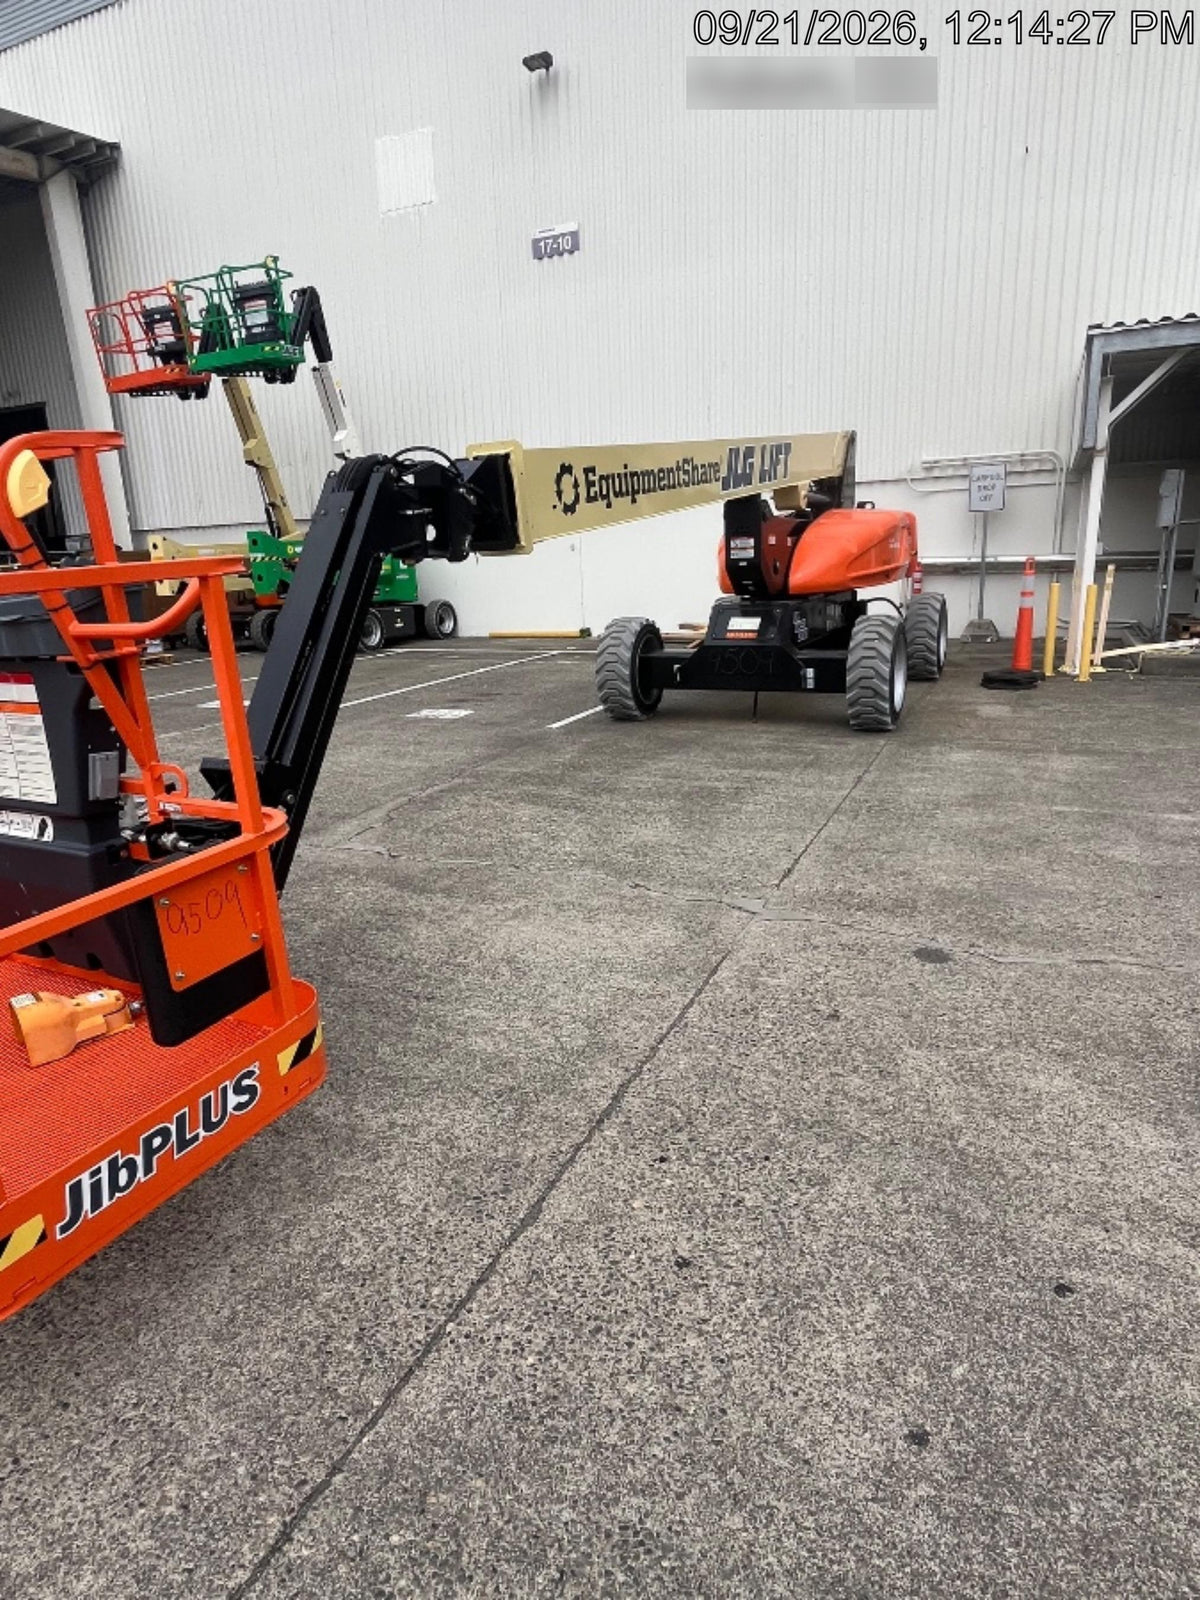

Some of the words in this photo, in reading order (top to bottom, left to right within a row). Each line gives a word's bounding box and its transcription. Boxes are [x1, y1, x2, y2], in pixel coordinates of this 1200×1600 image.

[537, 236, 572, 255] 17-10
[583, 456, 722, 509] EquipmentShare
[720, 445, 756, 493] JLG
[758, 442, 792, 485] LIFT
[57, 1065, 260, 1239] JibPLUS
